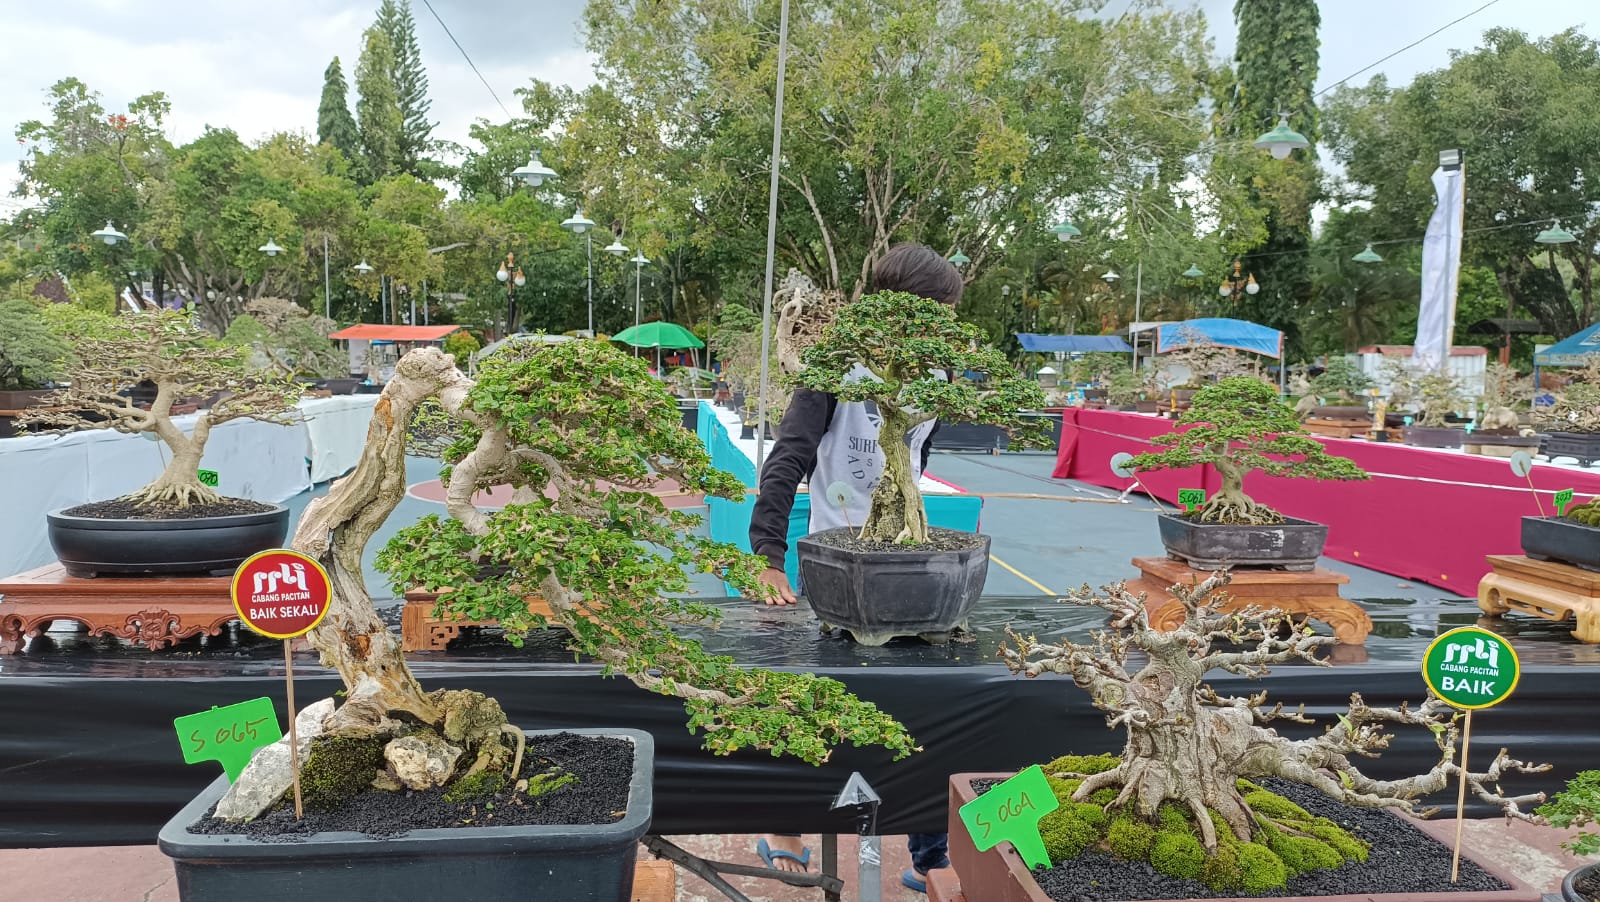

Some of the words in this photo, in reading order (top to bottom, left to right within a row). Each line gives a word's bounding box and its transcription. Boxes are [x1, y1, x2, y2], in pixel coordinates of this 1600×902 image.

[251, 593, 280, 603] CABANG
[281, 591, 310, 601] PACITAN
[250, 607, 277, 620] BAIK
[280, 603, 319, 618] SEKALI
[1440, 663, 1468, 673] CABANG
[1470, 666, 1499, 677] PACITAN
[1441, 676, 1496, 696] BAIK
[215, 717, 269, 744] 065
